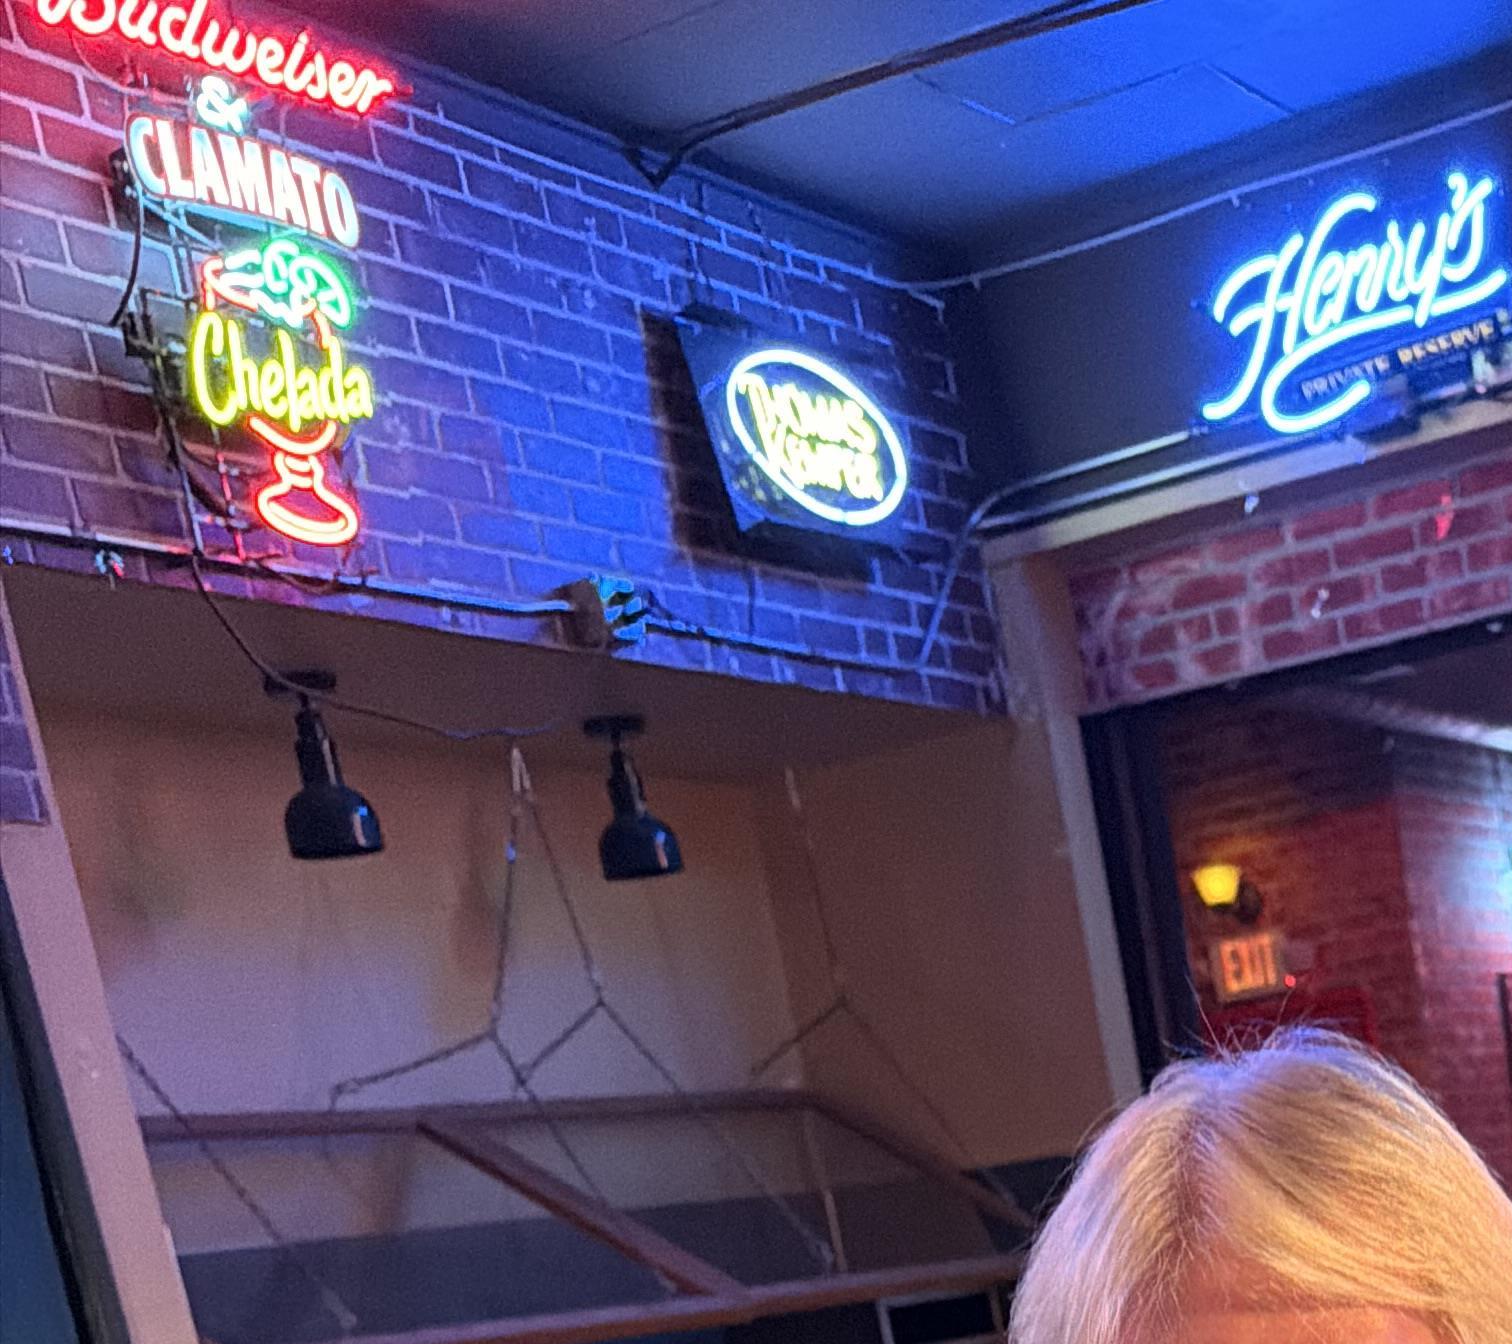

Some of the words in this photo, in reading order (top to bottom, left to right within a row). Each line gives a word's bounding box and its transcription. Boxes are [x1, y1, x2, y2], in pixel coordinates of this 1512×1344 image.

[197, 75, 248, 135] &
[131, 118, 360, 249] CLAMATO
[1203, 171, 1507, 432] Henry's
[194, 311, 374, 433] Chelada
[1301, 353, 1390, 400] PRIVATE
[1397, 319, 1494, 366] RESERVE
[1220, 932, 1278, 993] EXIT
